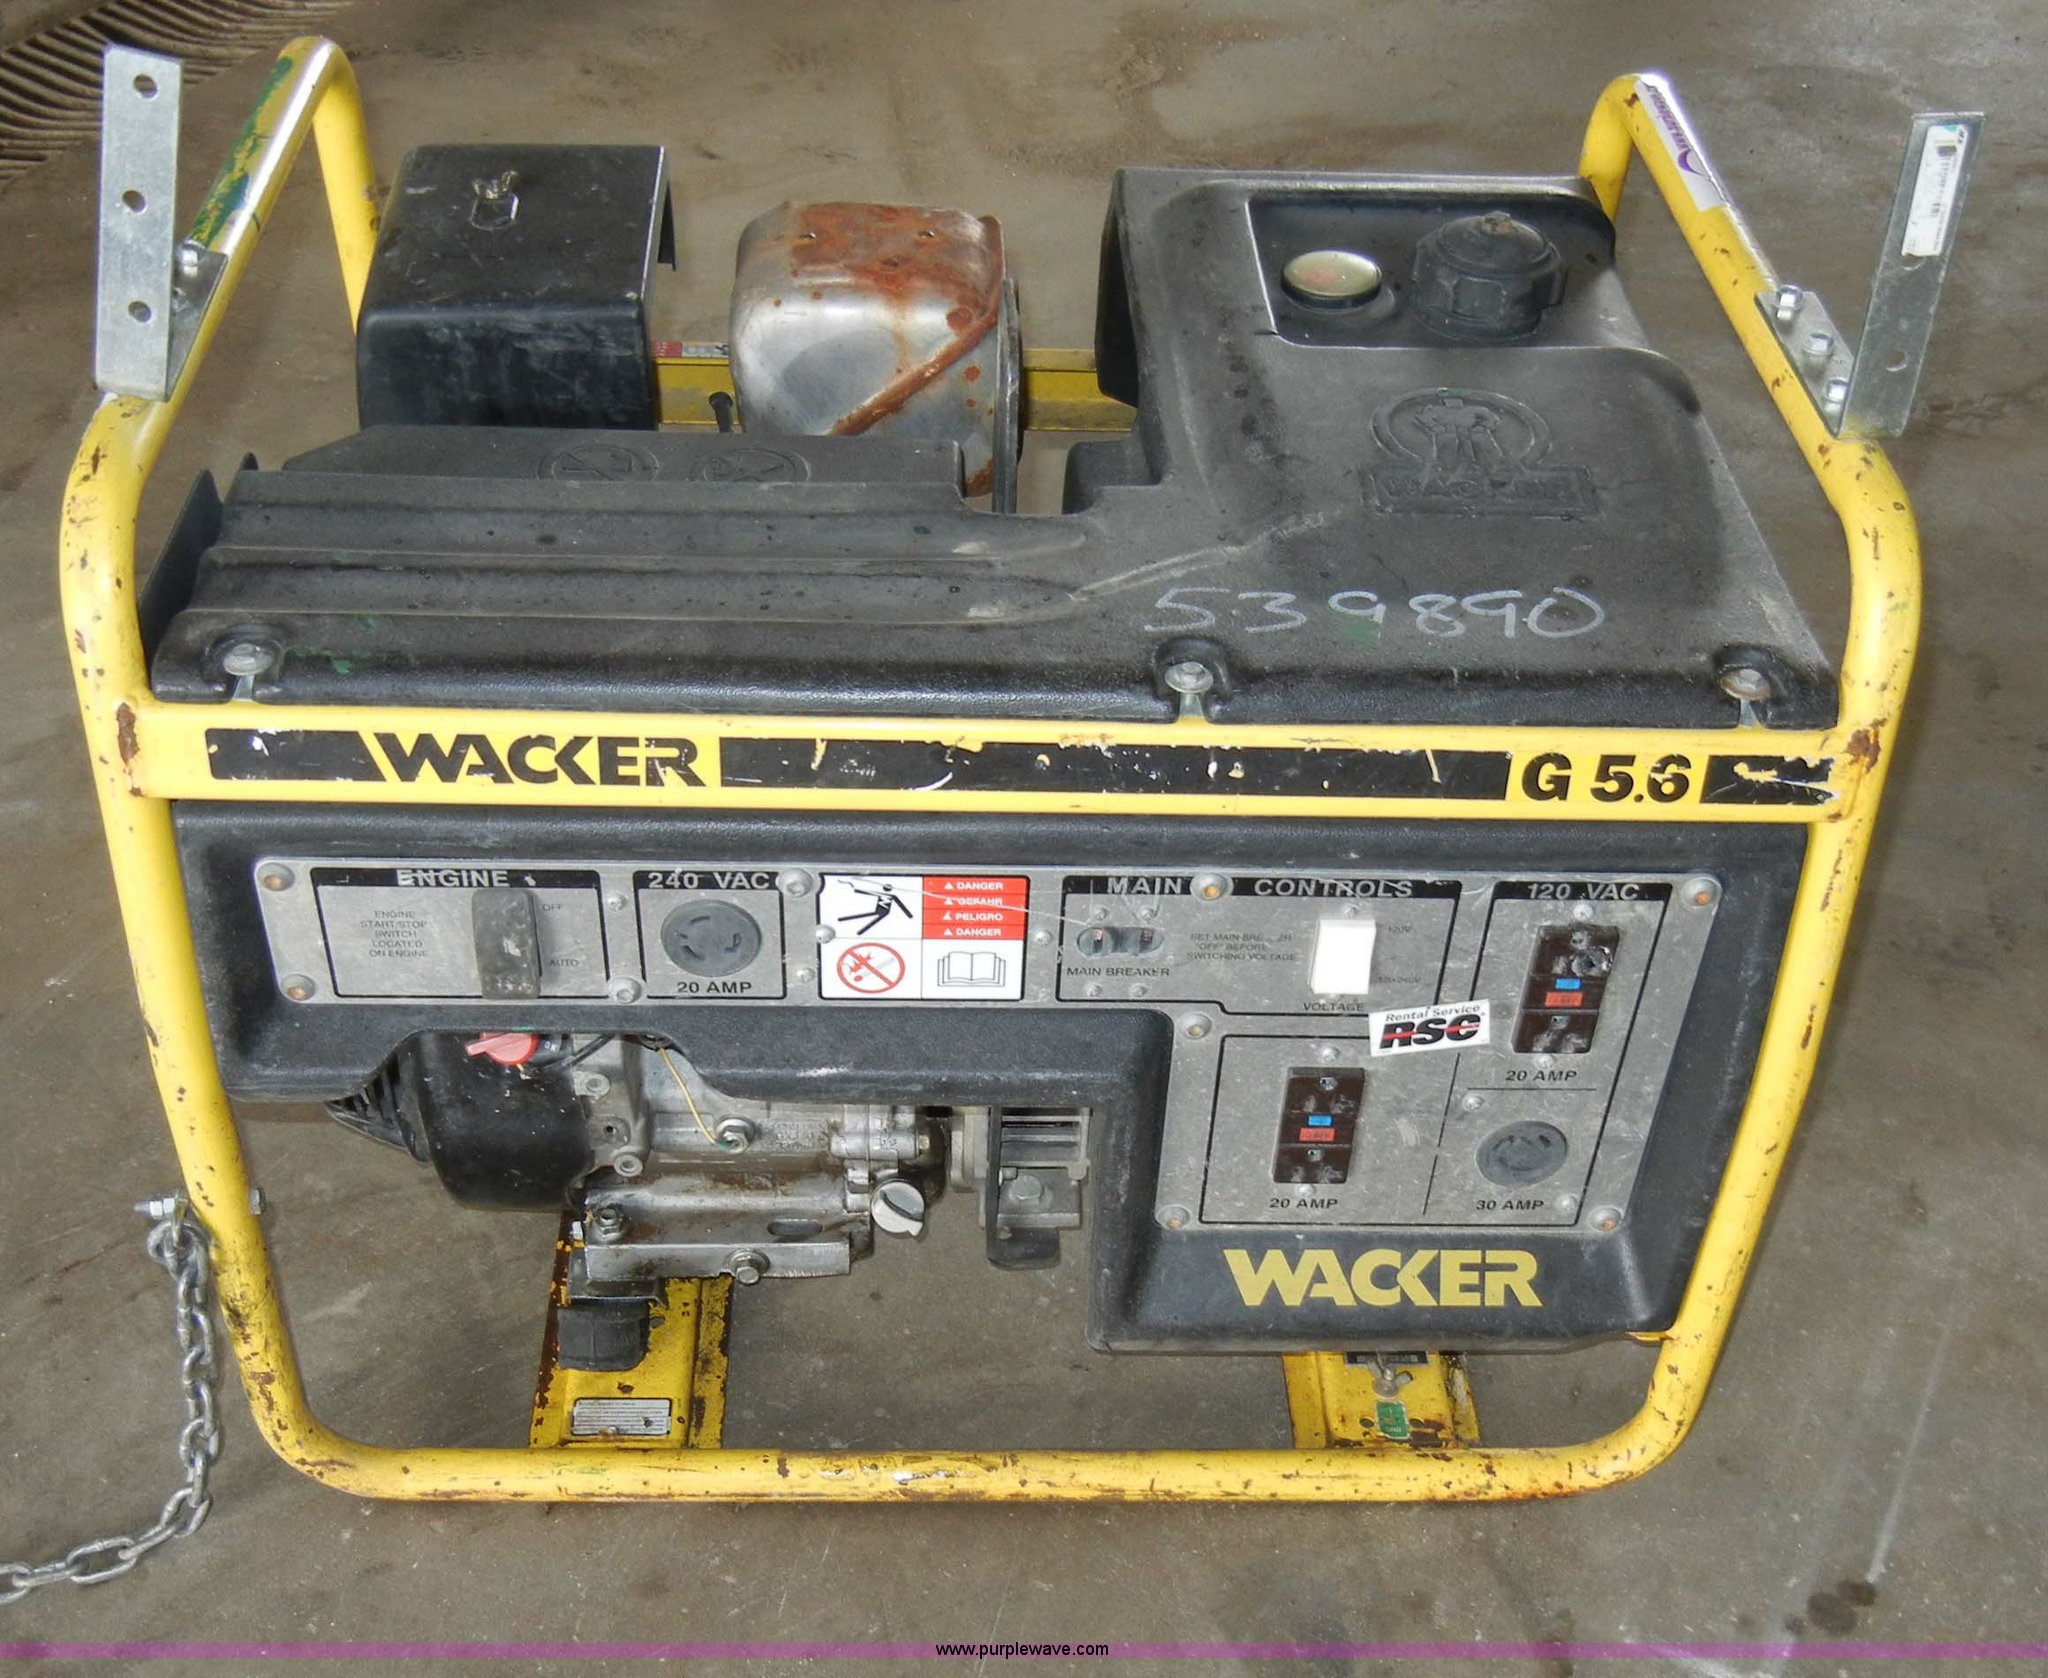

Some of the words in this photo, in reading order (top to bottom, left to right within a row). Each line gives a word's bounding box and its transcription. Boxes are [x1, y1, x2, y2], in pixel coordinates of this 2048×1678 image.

[373, 732, 707, 787] WACKER
[1521, 752, 1572, 802] G
[1590, 753, 1692, 803] 5.6
[396, 869, 511, 888] ENGINE
[648, 871, 699, 889] 240
[713, 872, 770, 890] VAC
[956, 881, 1004, 890] DANGER
[1106, 876, 1182, 895] MAIN
[1253, 878, 1413, 898] CONTROLS
[1527, 883, 1572, 900] 120
[1586, 883, 1641, 901] VAC
[956, 897, 1004, 906] GEFAHR
[542, 903, 564, 912] OFF
[374, 910, 416, 919] ENGINE
[955, 913, 1004, 922] PELIGRO
[374, 930, 417, 939] SWITCH
[955, 928, 1002, 937] DANGER
[1212, 933, 1240, 941] MAIN
[371, 940, 423, 949] LOCATED
[387, 950, 425, 958] ENGINE
[549, 958, 579, 967] AUTO
[1066, 967, 1102, 977] MAIN
[1105, 967, 1170, 977] BREAKER
[677, 981, 699, 994] 20
[705, 982, 752, 994] AMP
[1302, 1002, 1365, 1012] VOLTAGE
[1386, 1007, 1429, 1022] Rental
[1432, 1004, 1481, 1017] Service
[1379, 1013, 1481, 1050] RSC
[1505, 1069, 1528, 1082] 20
[1533, 1070, 1578, 1082] AMP
[1268, 1197, 1291, 1210] 20
[1297, 1198, 1339, 1210] AMP
[1475, 1198, 1497, 1211] 30
[1503, 1199, 1545, 1211] AMP
[1223, 1248, 1543, 1307] WACKER
